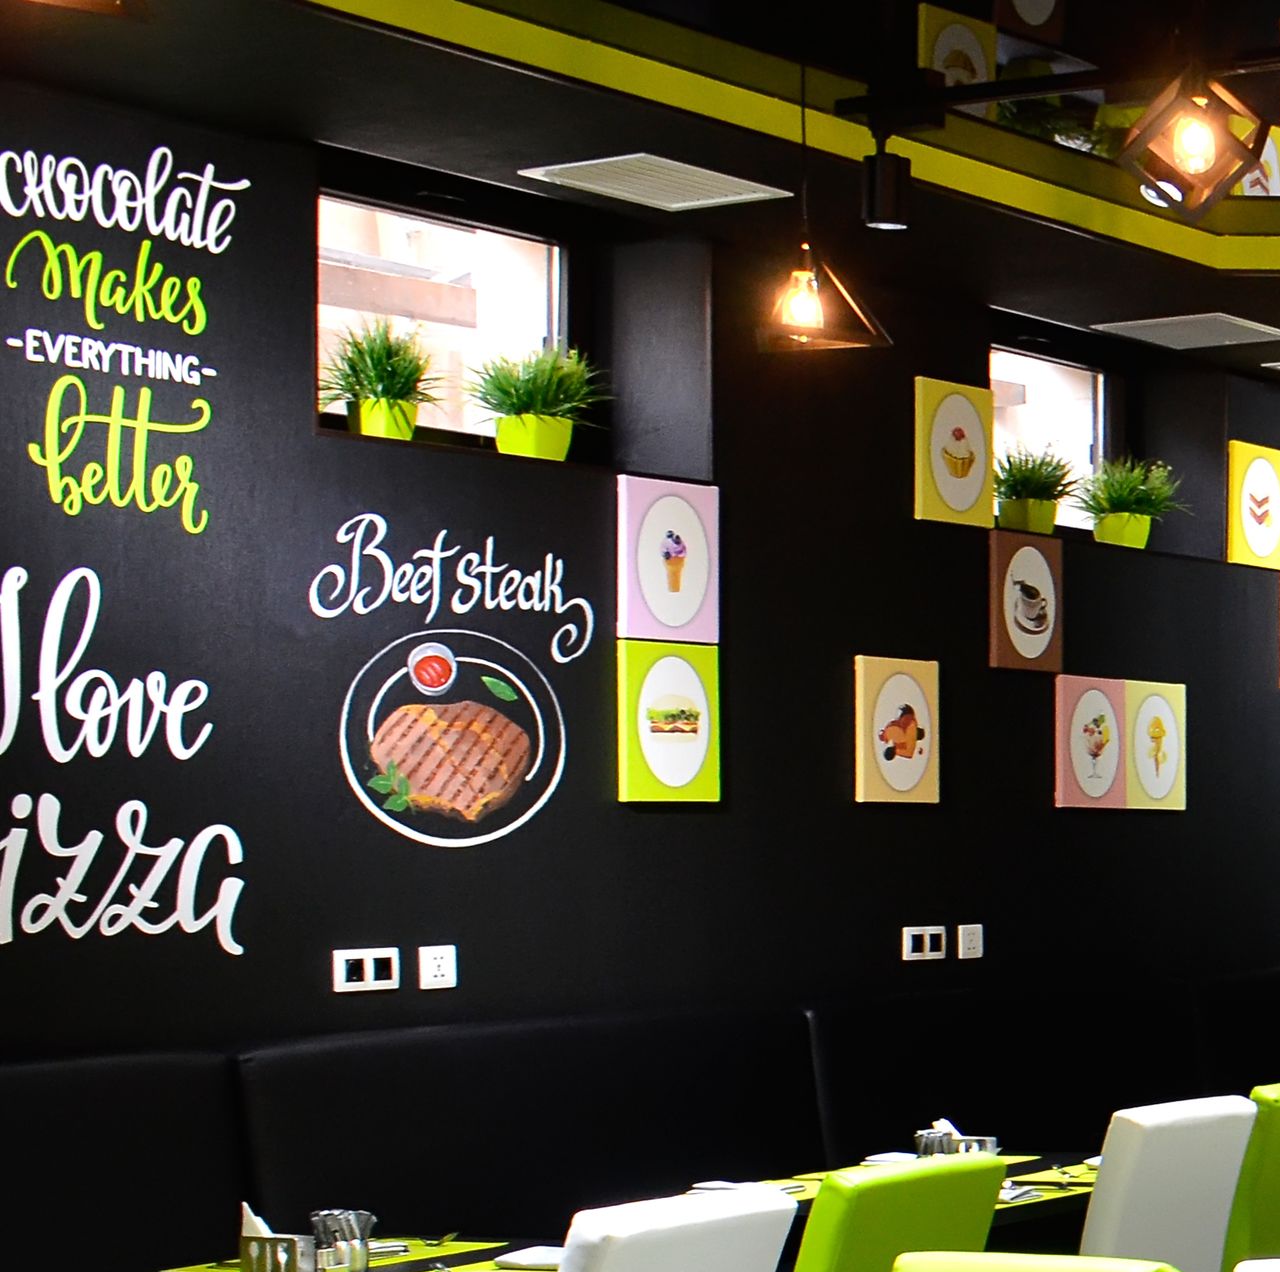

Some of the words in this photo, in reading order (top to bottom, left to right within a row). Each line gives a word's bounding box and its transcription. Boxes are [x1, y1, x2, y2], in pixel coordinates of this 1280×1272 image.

[27, 374, 212, 534] better
[31, 567, 214, 763] love
[451, 535, 594, 663] steak
[0, 792, 245, 956] izza
